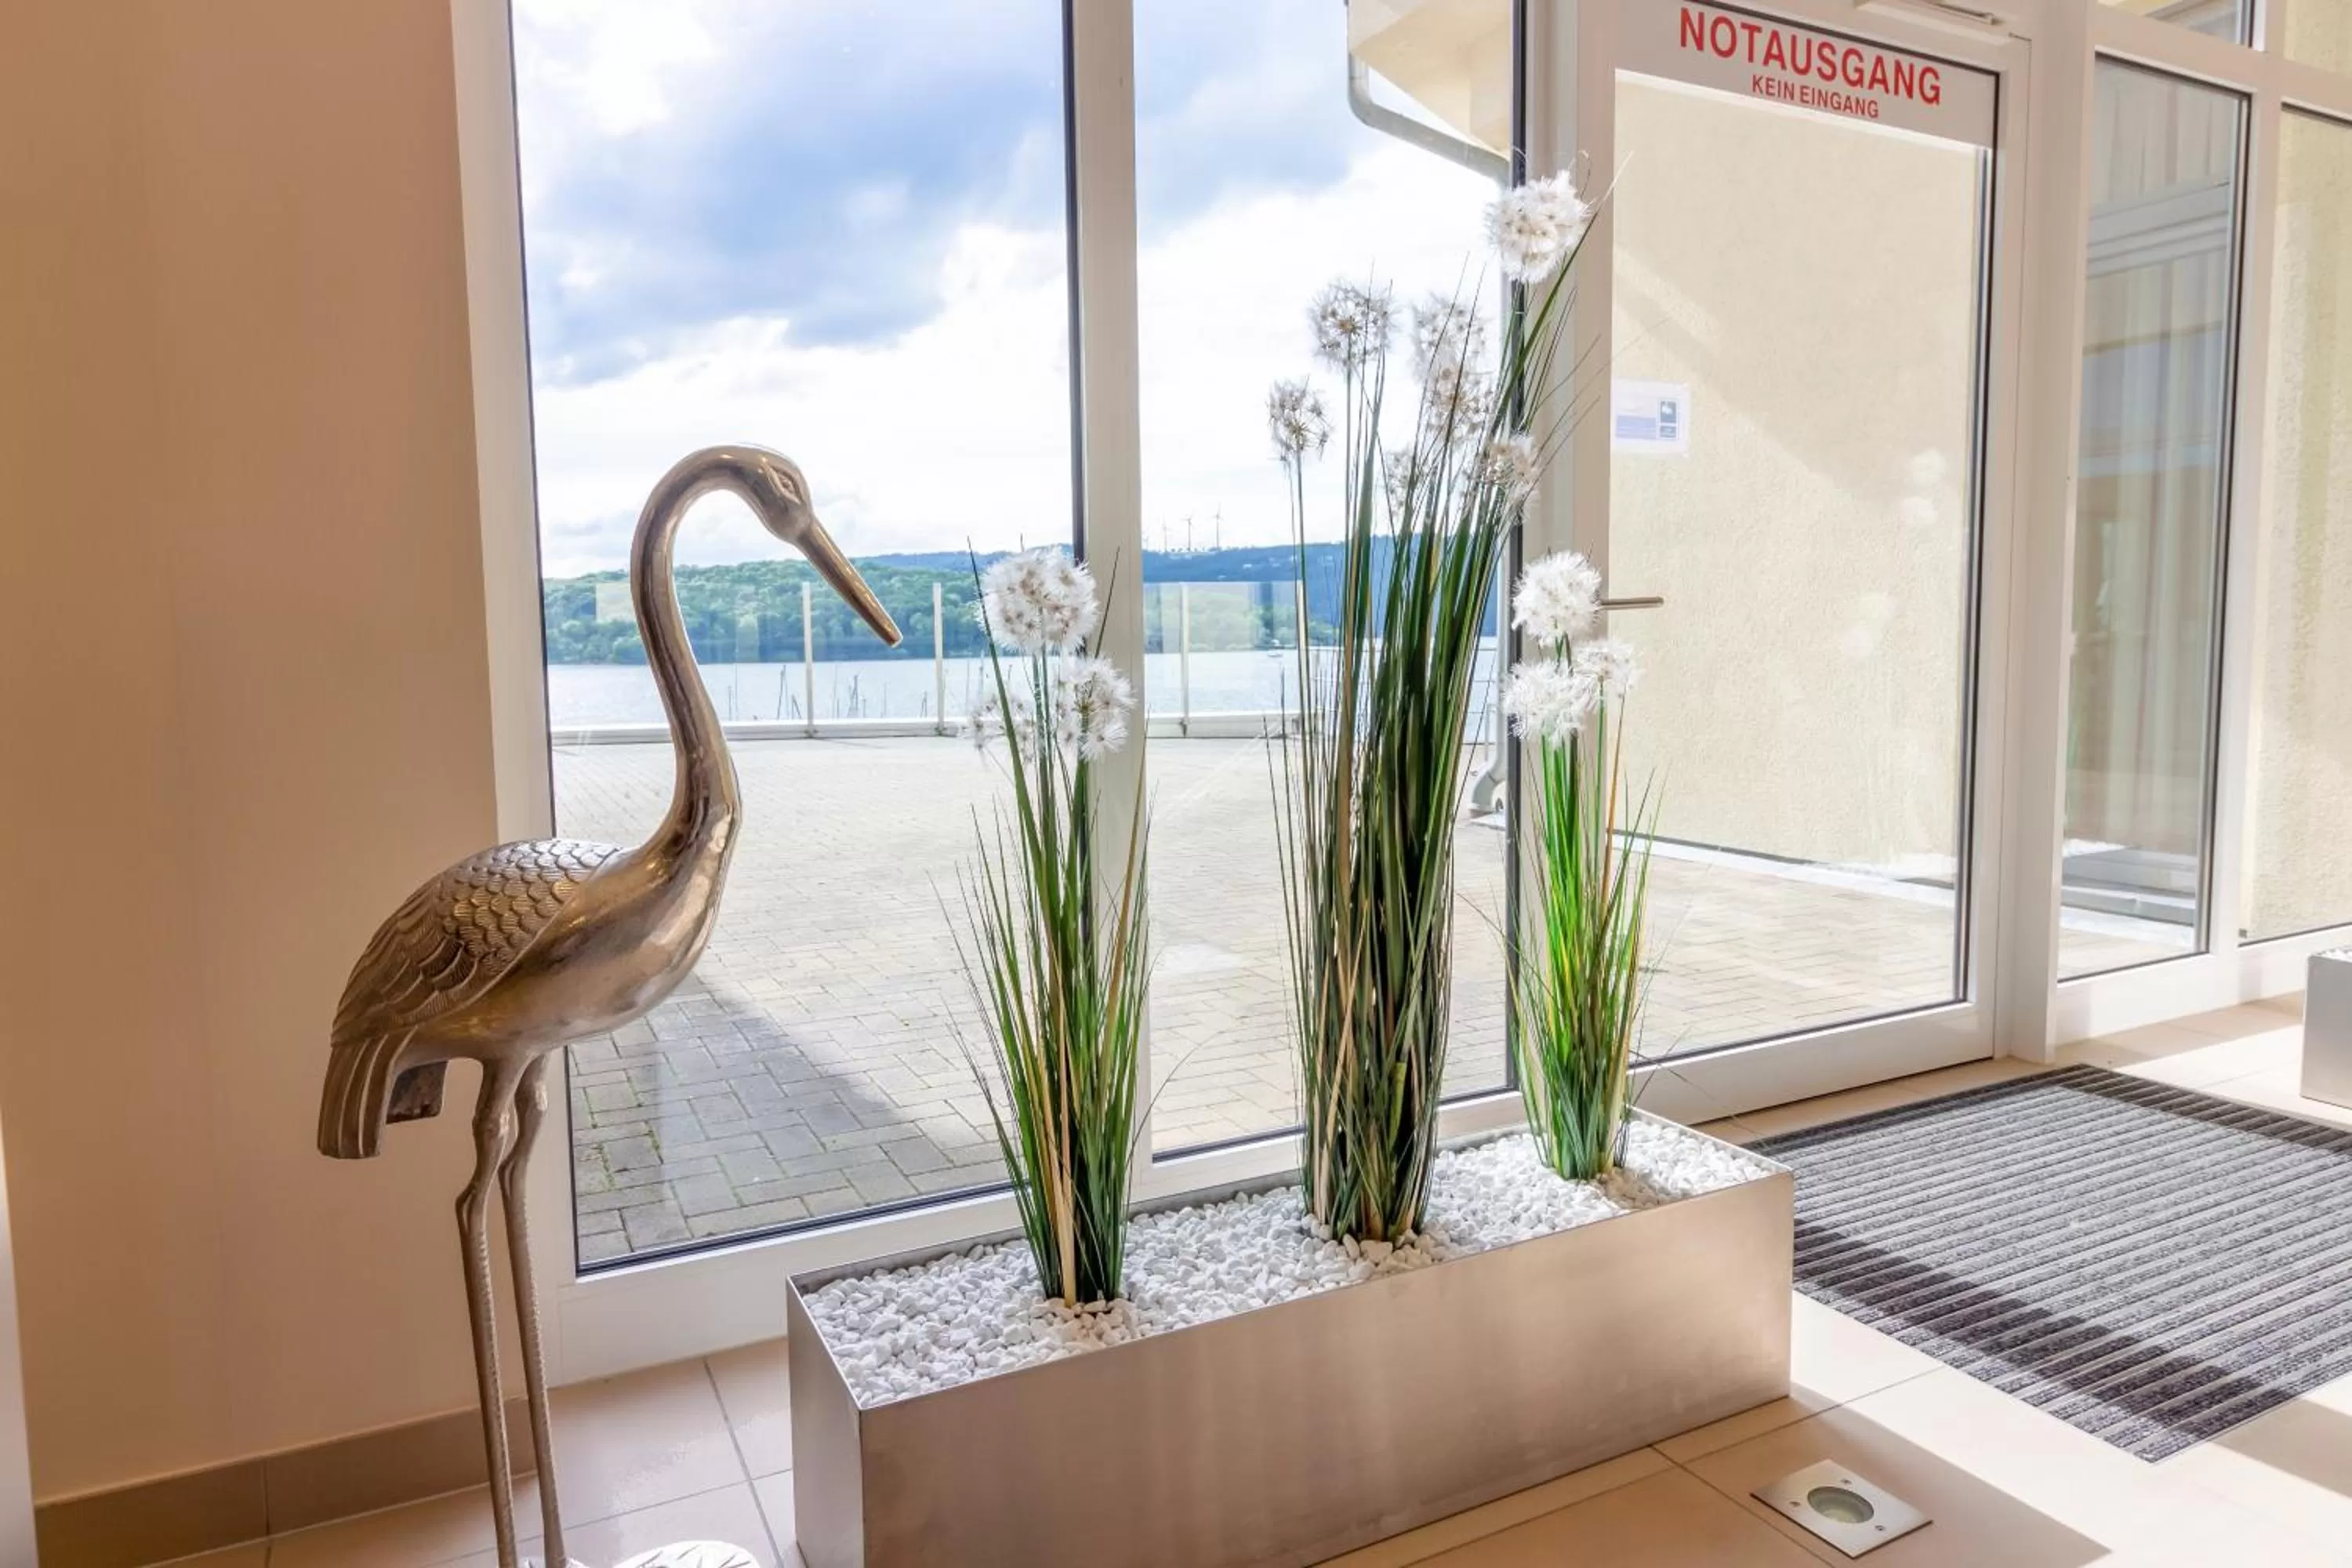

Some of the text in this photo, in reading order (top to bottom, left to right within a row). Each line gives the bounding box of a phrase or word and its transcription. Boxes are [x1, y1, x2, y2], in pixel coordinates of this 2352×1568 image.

[1679, 7, 1941, 107] NOTAUSGANG
[1751, 74, 1879, 118] KEIN EINGANG
